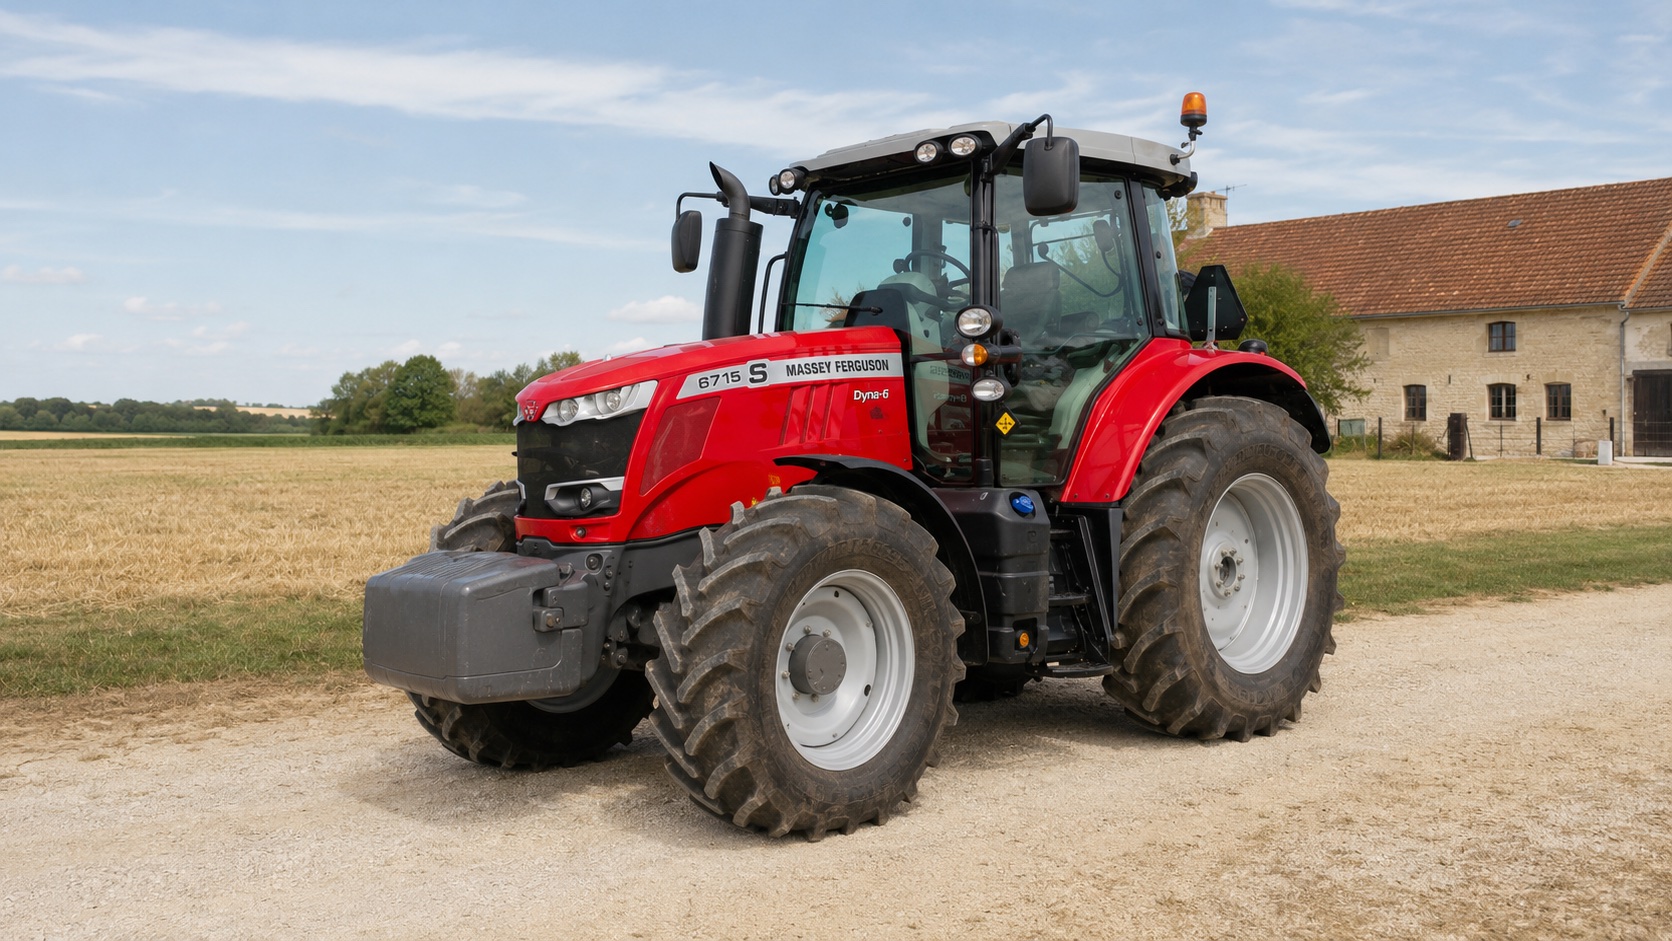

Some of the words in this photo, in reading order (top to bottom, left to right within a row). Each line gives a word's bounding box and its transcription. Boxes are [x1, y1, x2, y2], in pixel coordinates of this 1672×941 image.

[698, 370, 741, 389] 6715
[749, 362, 768, 384] S
[786, 361, 831, 377] MASSEY
[835, 359, 889, 372] FERGUSON
[853, 389, 889, 403] Dyna-6
